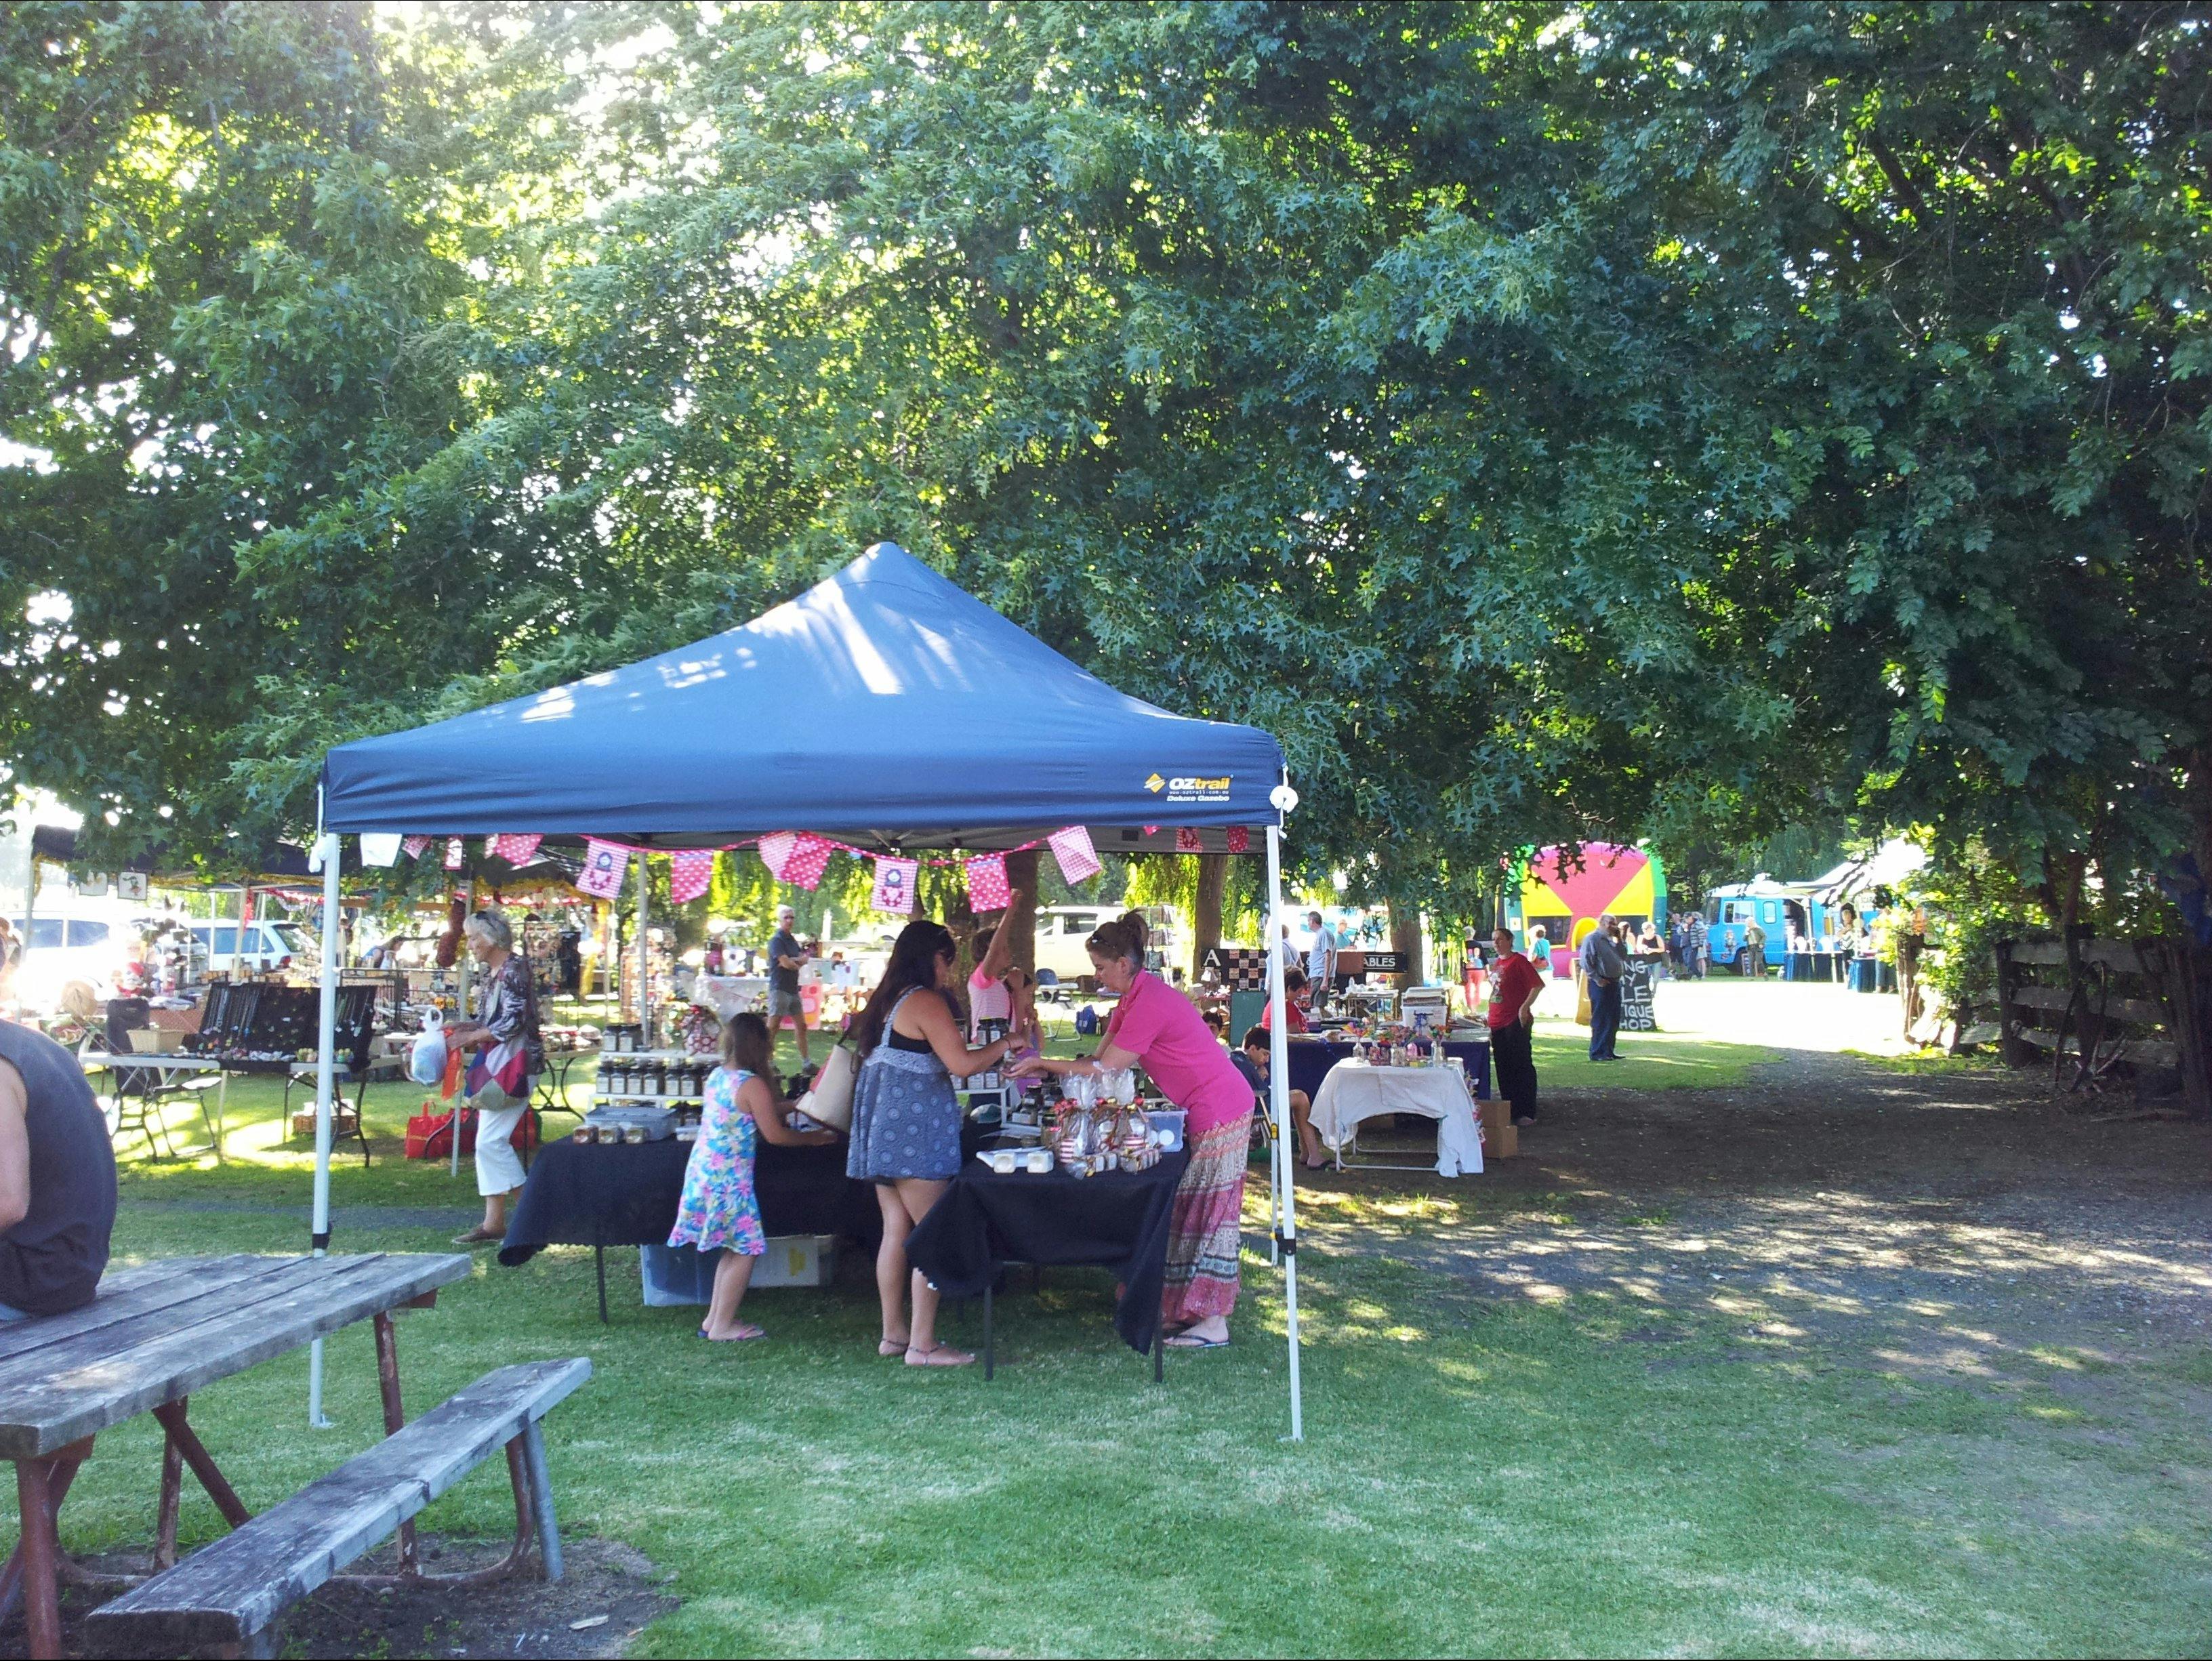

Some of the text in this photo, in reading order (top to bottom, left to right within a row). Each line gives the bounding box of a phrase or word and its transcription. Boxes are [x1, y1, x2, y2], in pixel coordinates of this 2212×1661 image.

[1169, 777, 1230, 790] OZtrail
[1363, 957, 1396, 967] ABLES
[1621, 985, 1651, 1003] LE
[1619, 1019, 1652, 1030] HOP
